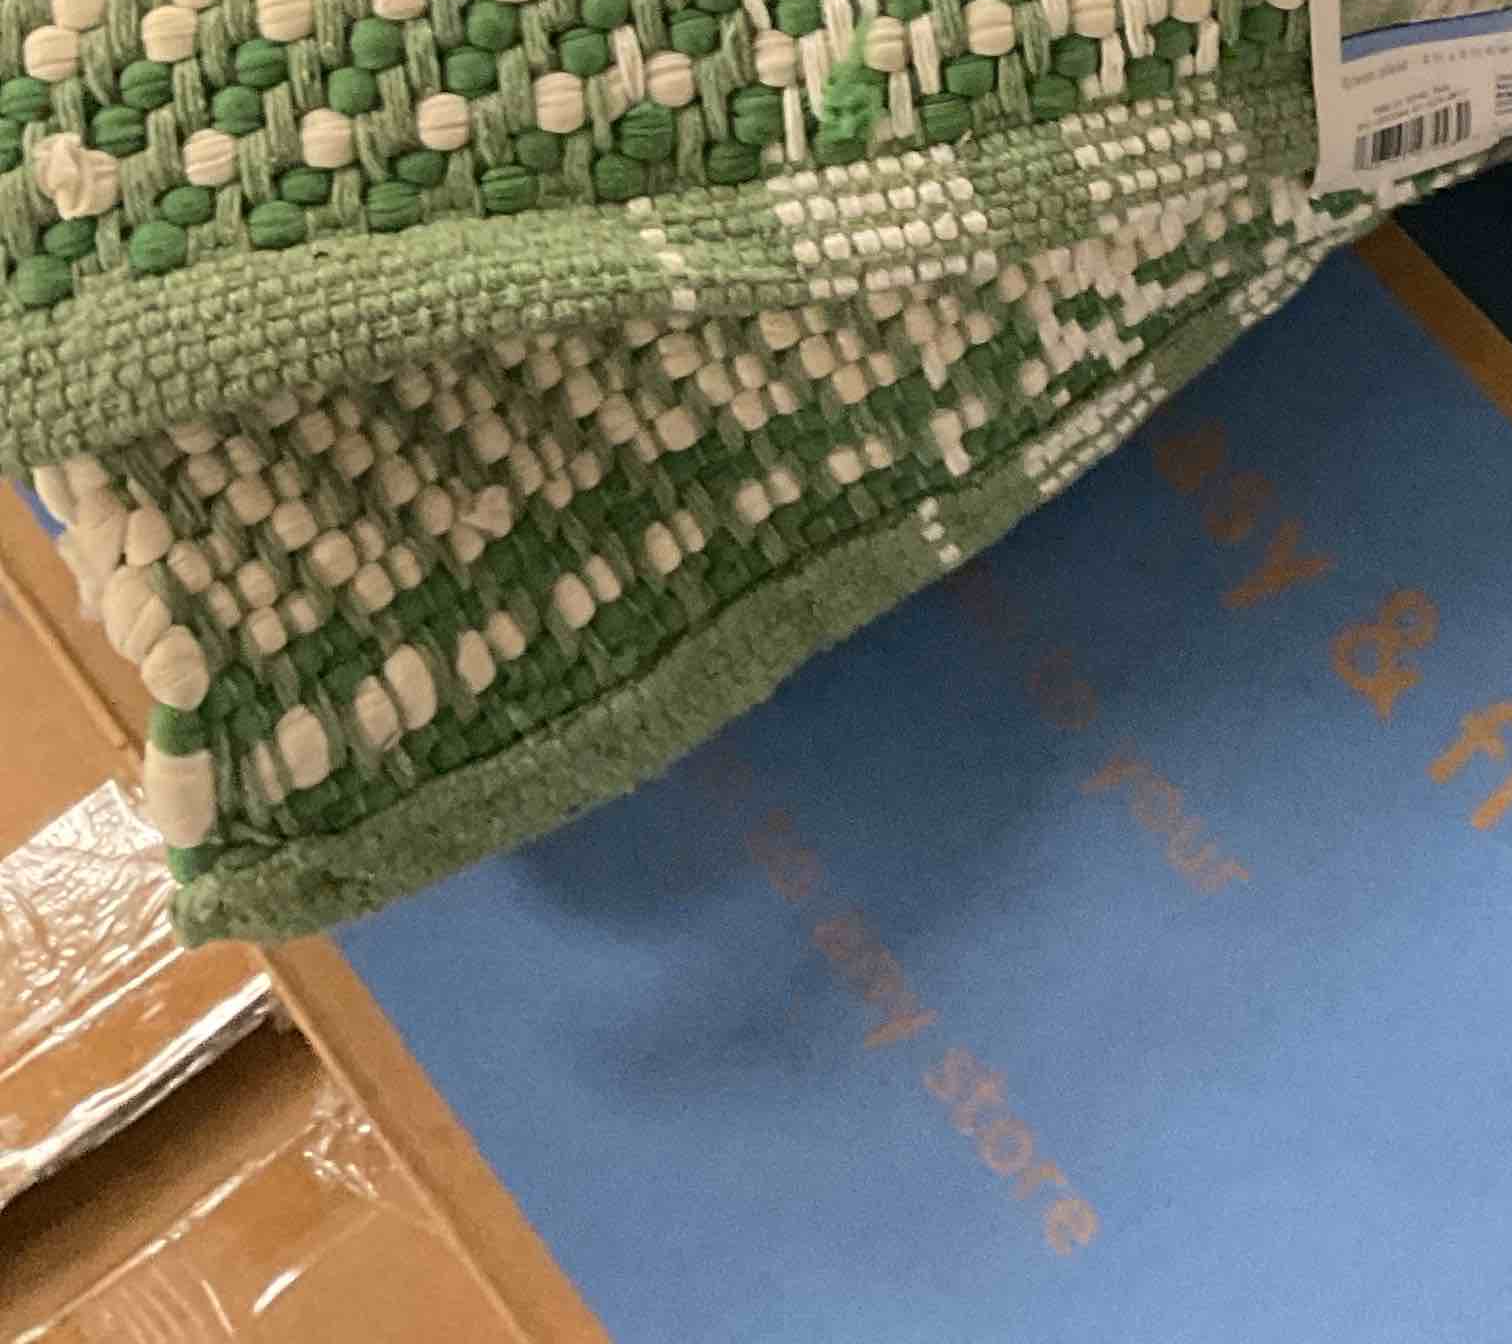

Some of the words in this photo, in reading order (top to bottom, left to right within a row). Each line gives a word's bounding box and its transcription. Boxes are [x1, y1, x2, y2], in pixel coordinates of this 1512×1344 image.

[1152, 417, 1340, 612] asy
[1328, 584, 1441, 728] &
[920, 1045, 1098, 1258] store
